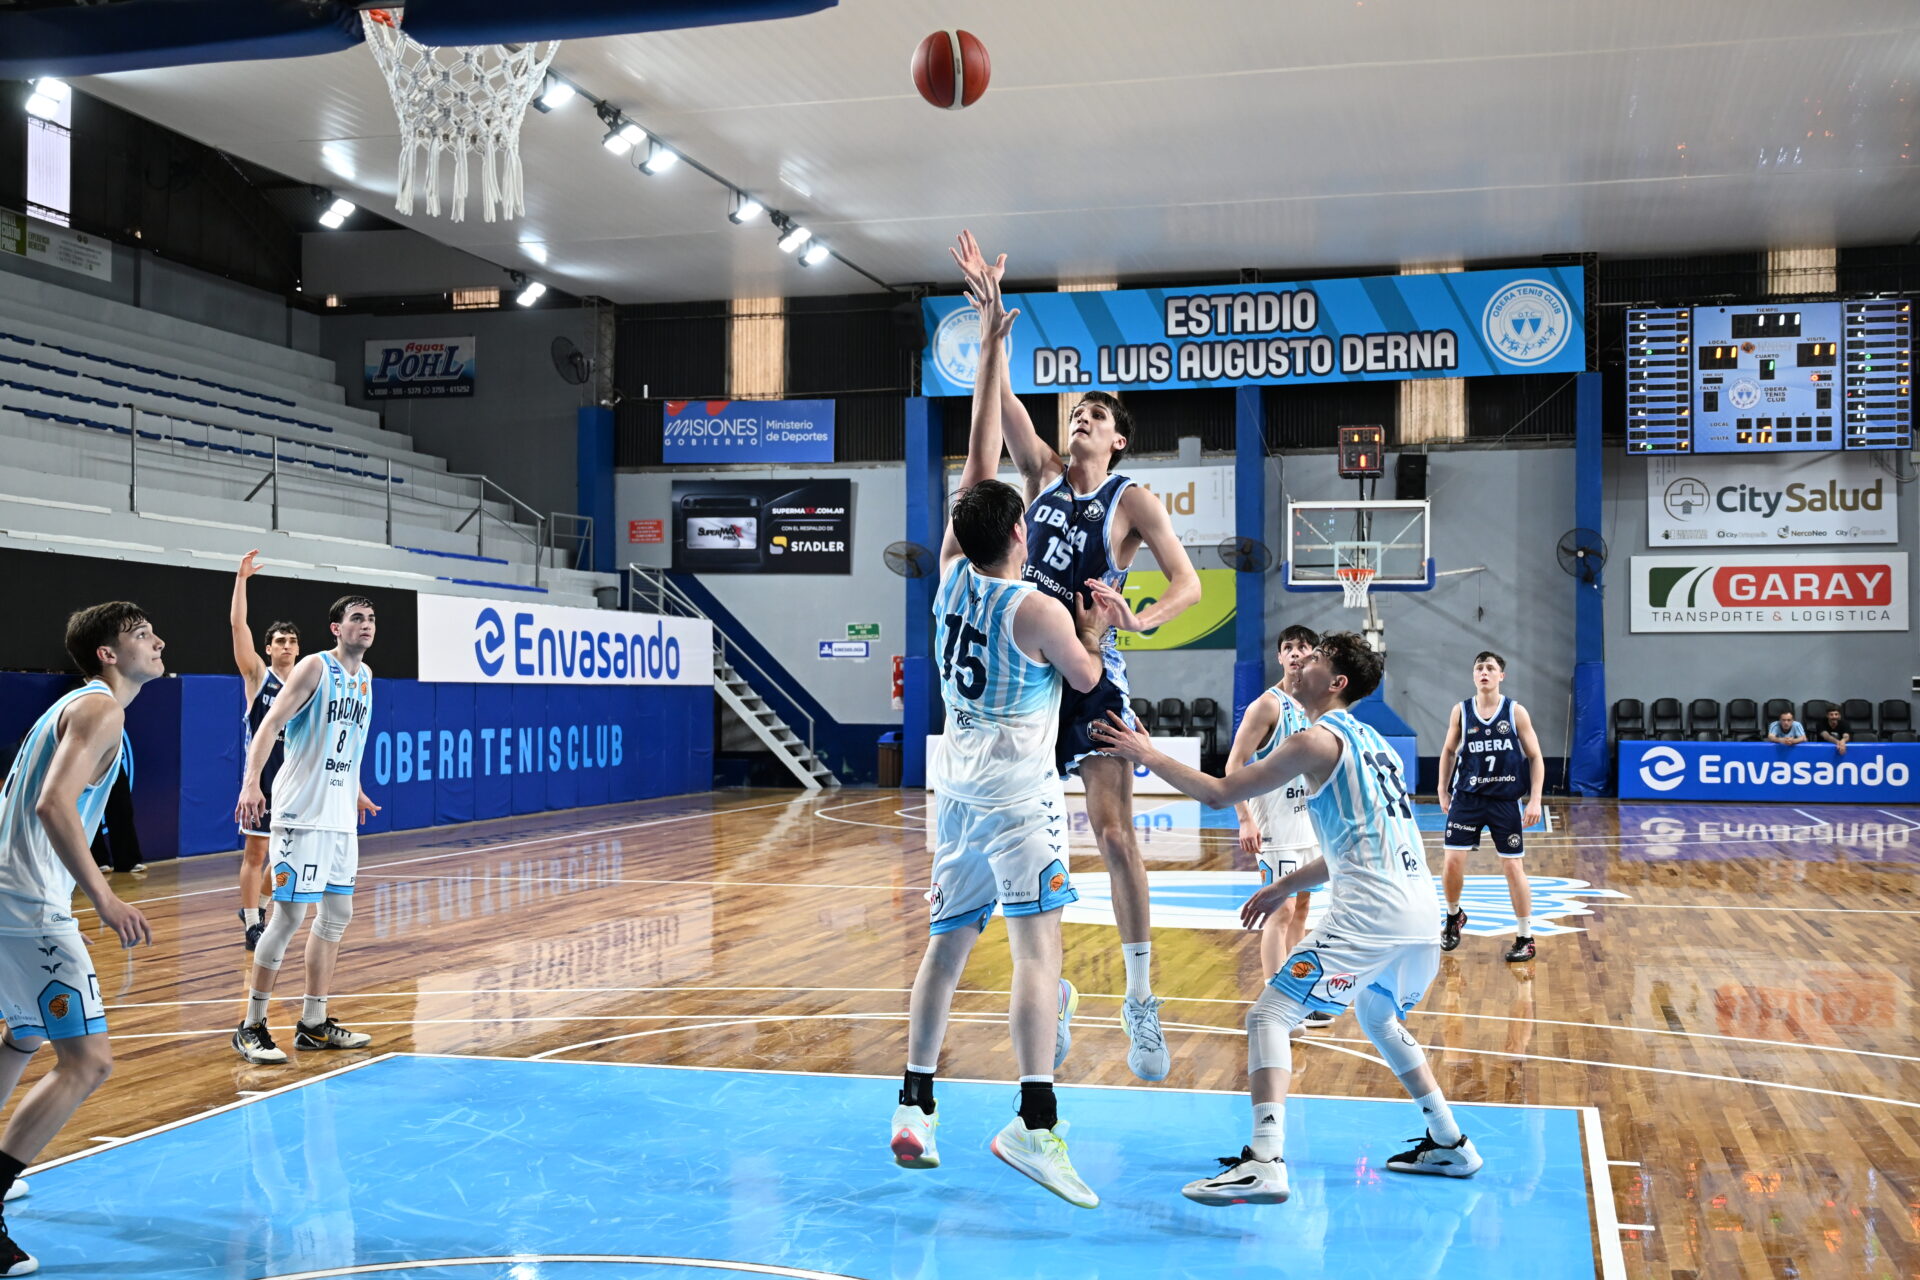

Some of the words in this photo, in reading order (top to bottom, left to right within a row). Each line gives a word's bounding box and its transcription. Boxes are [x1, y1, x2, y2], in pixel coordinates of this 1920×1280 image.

[1493, 291, 1516, 317] OBERA
[1517, 288, 1543, 297] TENIS
[1544, 294, 1561, 315] CLUB
[1167, 290, 1317, 336] ESTADIO
[405, 342, 445, 353] Aguas
[1035, 348, 1091, 385] DR.
[1099, 345, 1171, 382] LUIS
[1178, 336, 1333, 381] AUGUSTO
[1340, 329, 1457, 374] DERNA
[664, 418, 758, 437] MISIONES
[766, 420, 813, 430] Ministerio
[664, 438, 758, 446] GOBIERNO
[766, 432, 779, 441] de
[782, 432, 828, 443] Deportes
[791, 541, 844, 552] STADLER
[1042, 536, 1073, 571] 15
[1729, 572, 1884, 601] GARAY
[1652, 611, 1764, 622] TRANSPORTE
[1772, 611, 1783, 622] &
[1791, 610, 1890, 622] LOGISTICA
[514, 612, 680, 680] Envasando
[942, 613, 988, 700] 15
[336, 729, 347, 754] 8
[1468, 739, 1514, 753] OBERA
[1485, 755, 1497, 772] 7
[1700, 755, 1909, 787] Envasando
[1478, 774, 1516, 783] Envasando
